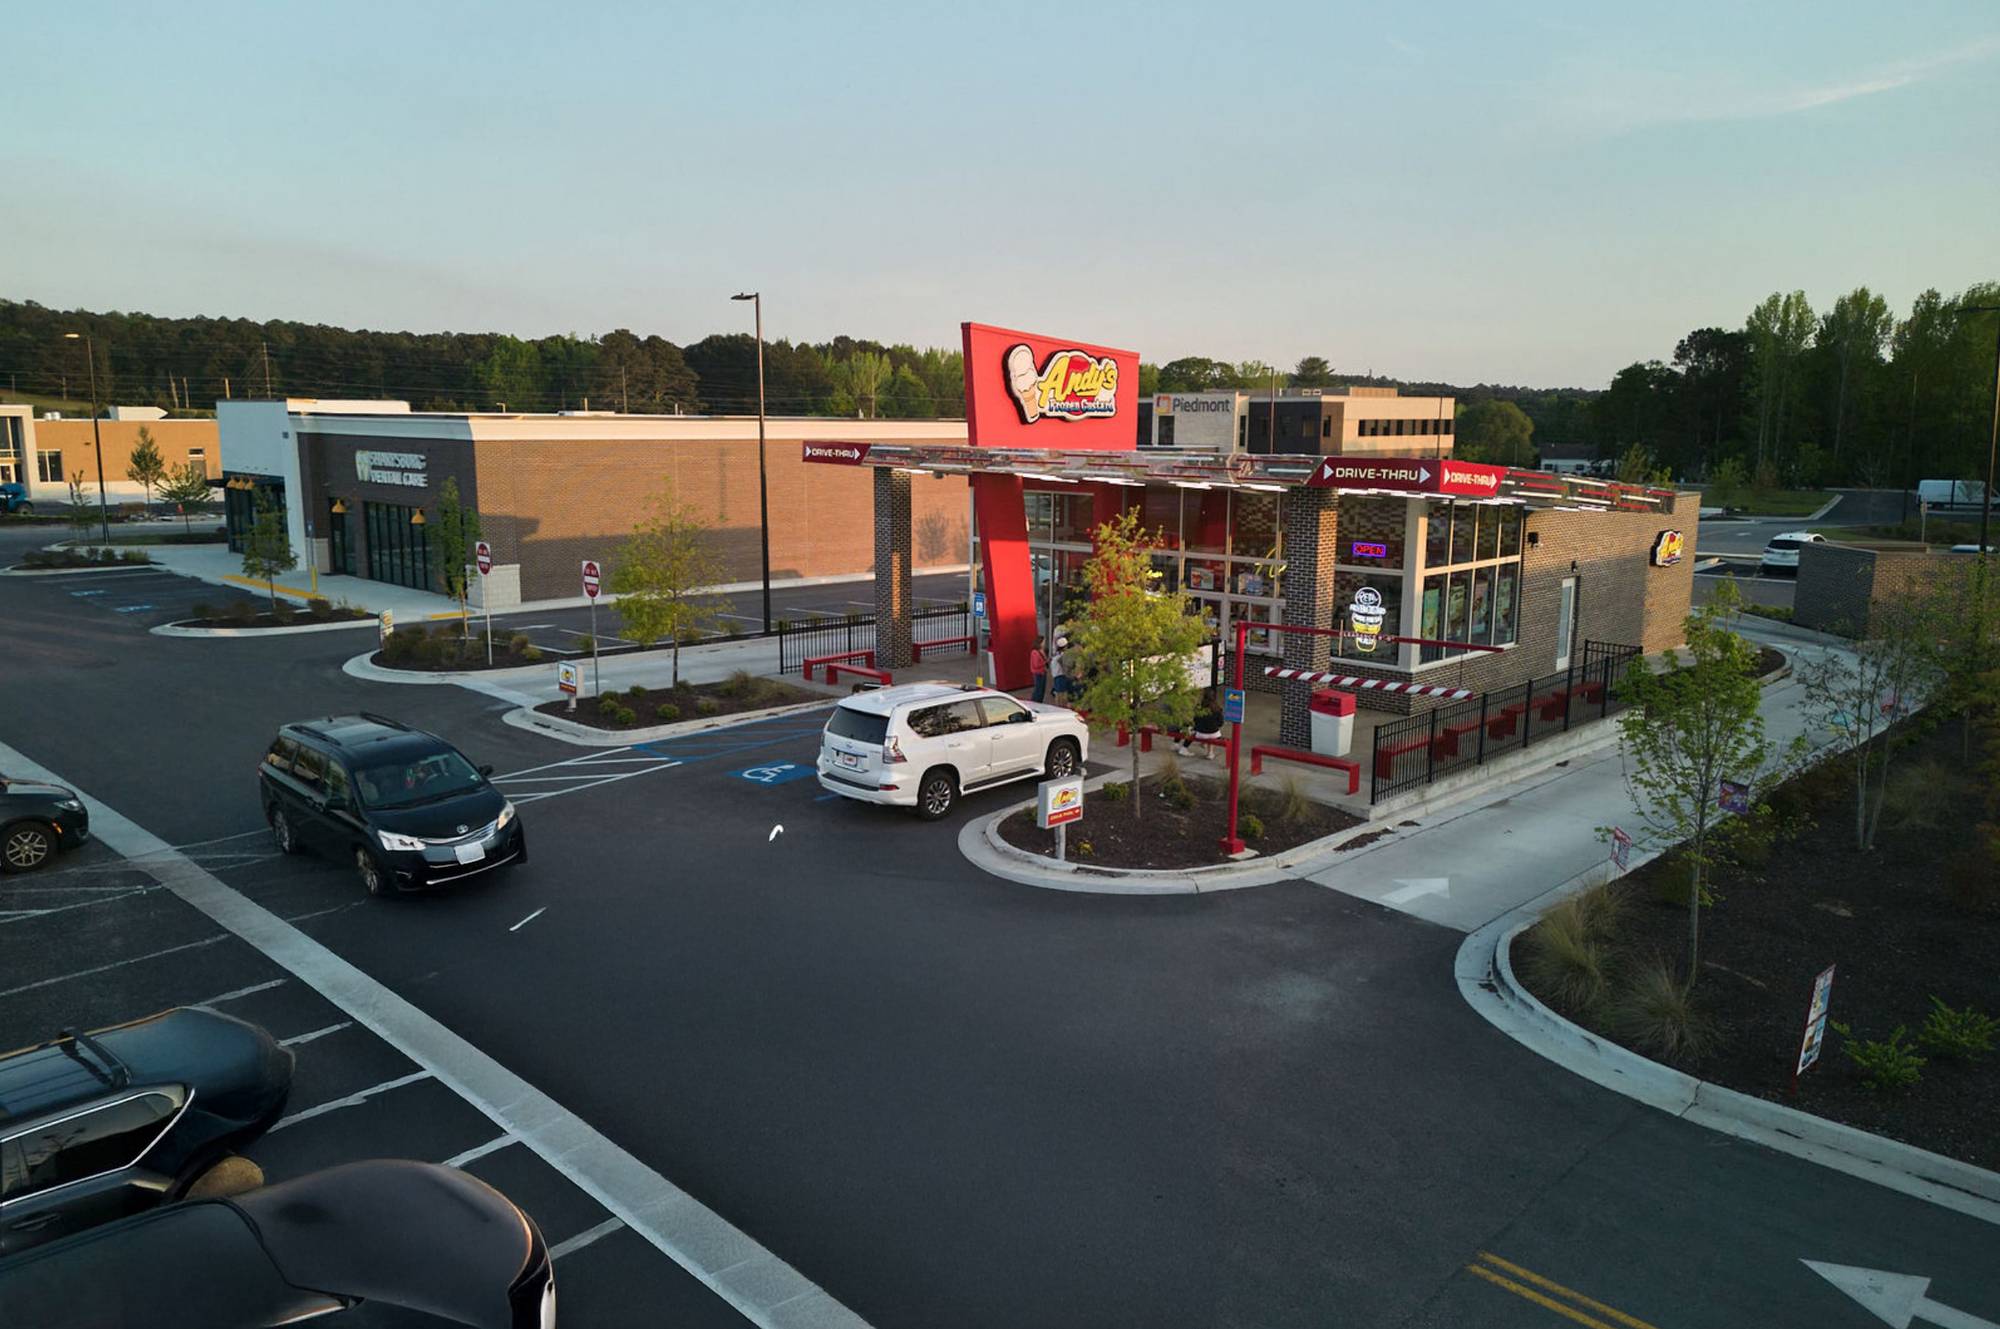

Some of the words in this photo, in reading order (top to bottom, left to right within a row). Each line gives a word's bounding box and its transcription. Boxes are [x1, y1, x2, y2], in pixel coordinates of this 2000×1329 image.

[1038, 355, 1115, 408] Andy's
[1049, 398, 1080, 411] Frozen
[1081, 398, 1114, 412] Custard
[1173, 397, 1230, 412] Piedmont
[811, 447, 854, 458] DRIVE-THRU
[370, 470, 402, 485] DENTAL
[403, 472, 428, 487] CARE
[1335, 467, 1418, 481] DRIVE-THRU
[1451, 472, 1491, 487] DRIVE-THRU
[1354, 544, 1383, 555] OPEN
